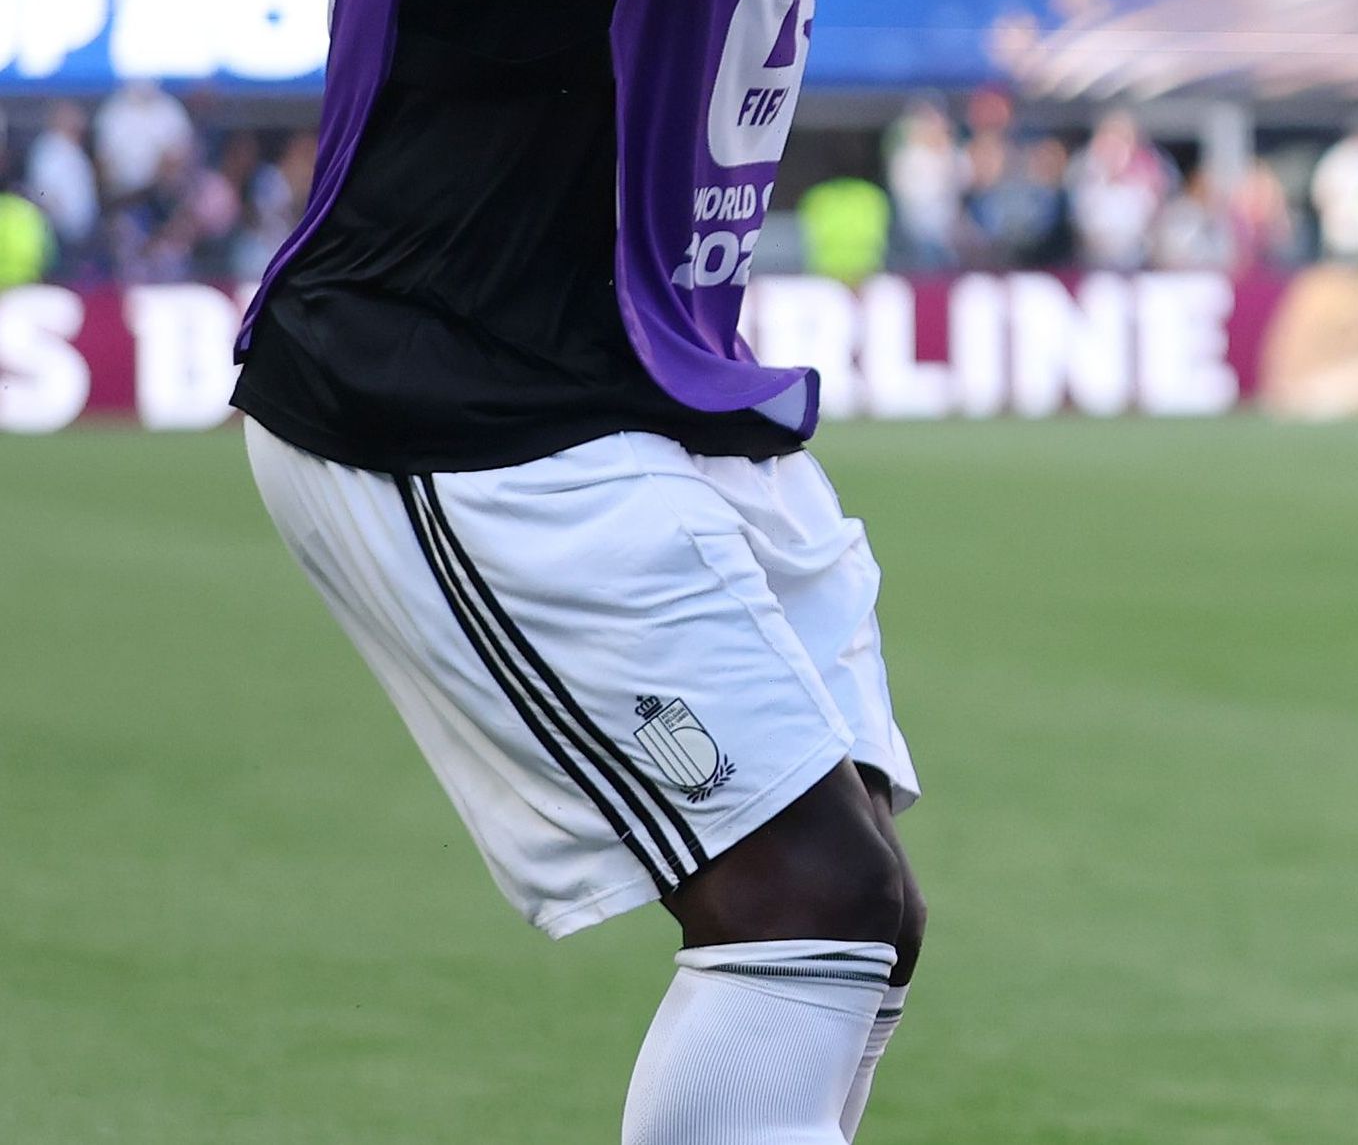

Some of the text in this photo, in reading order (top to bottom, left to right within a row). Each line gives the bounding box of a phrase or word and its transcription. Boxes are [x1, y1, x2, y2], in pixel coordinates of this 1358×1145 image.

[737, 87, 790, 126] FIF
[671, 229, 762, 290] 202
[746, 271, 1241, 418] RLINE
